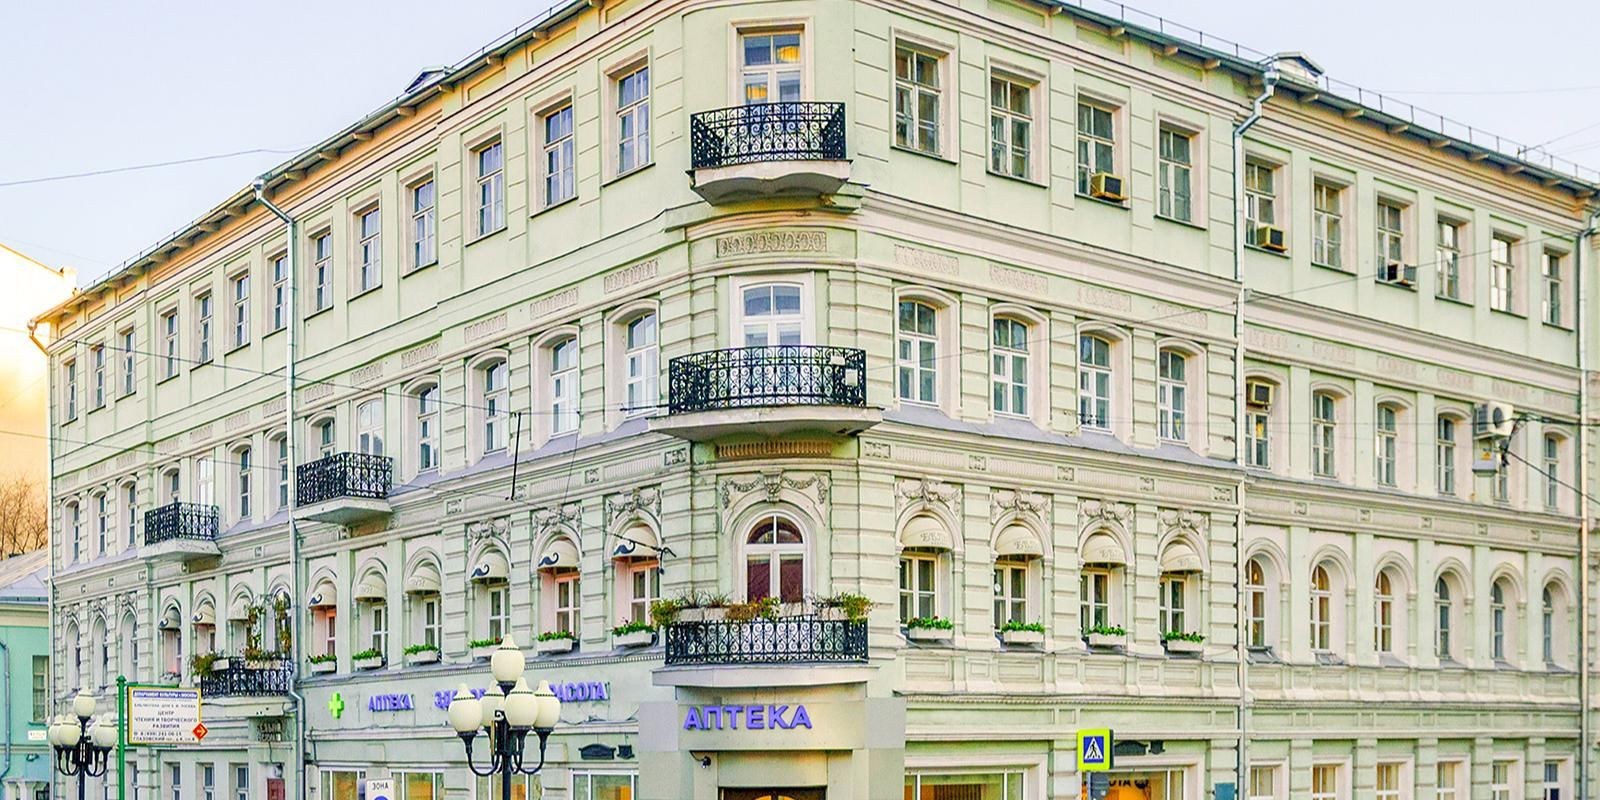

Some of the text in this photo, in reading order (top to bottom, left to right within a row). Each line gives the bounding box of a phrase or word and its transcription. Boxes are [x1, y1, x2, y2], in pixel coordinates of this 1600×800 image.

[368, 693, 413, 712] АПТЕКА
[549, 682, 607, 703] АСОТА
[683, 704, 813, 730] АПТЕКА
[372, 781, 389, 791] ЗОНА
